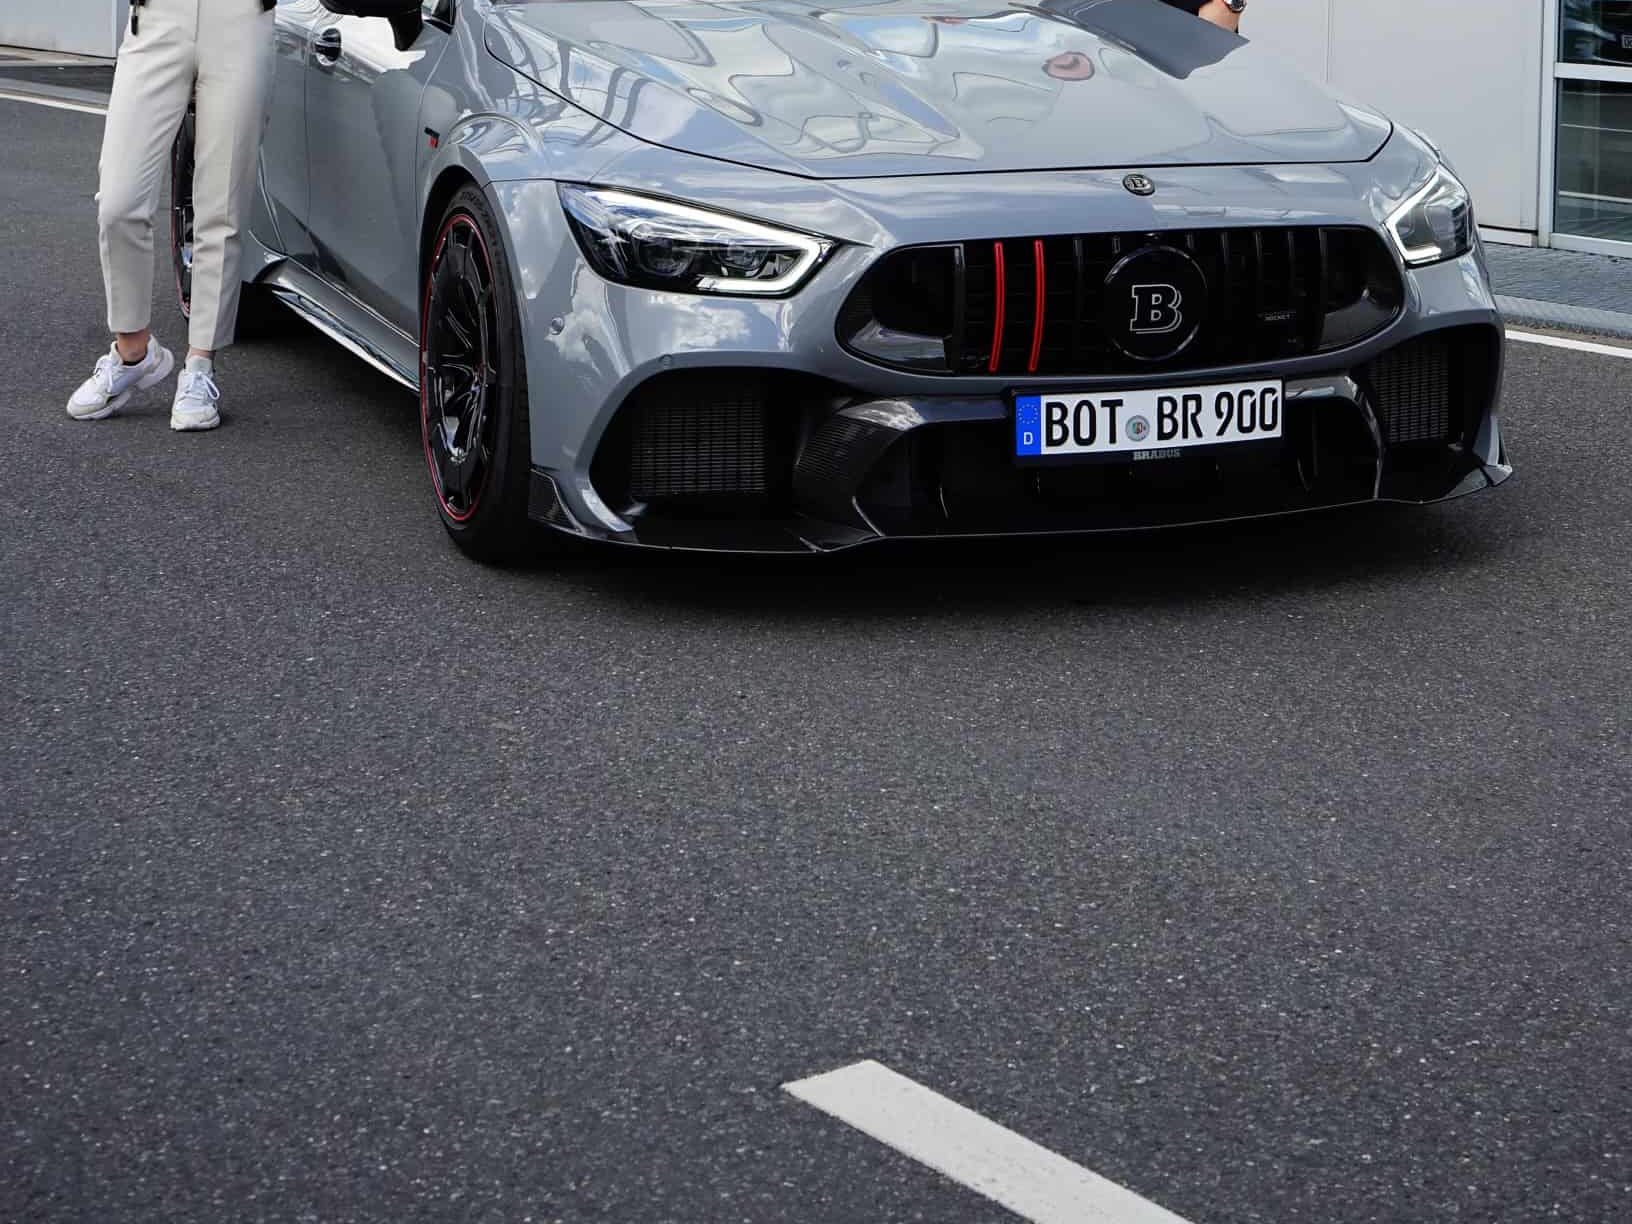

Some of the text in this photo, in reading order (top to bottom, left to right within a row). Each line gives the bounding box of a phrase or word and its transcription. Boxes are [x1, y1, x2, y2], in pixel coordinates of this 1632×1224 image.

[1130, 284, 1182, 334] B
[1023, 432, 1033, 445] D
[1045, 387, 1278, 447] BOT BR 900
